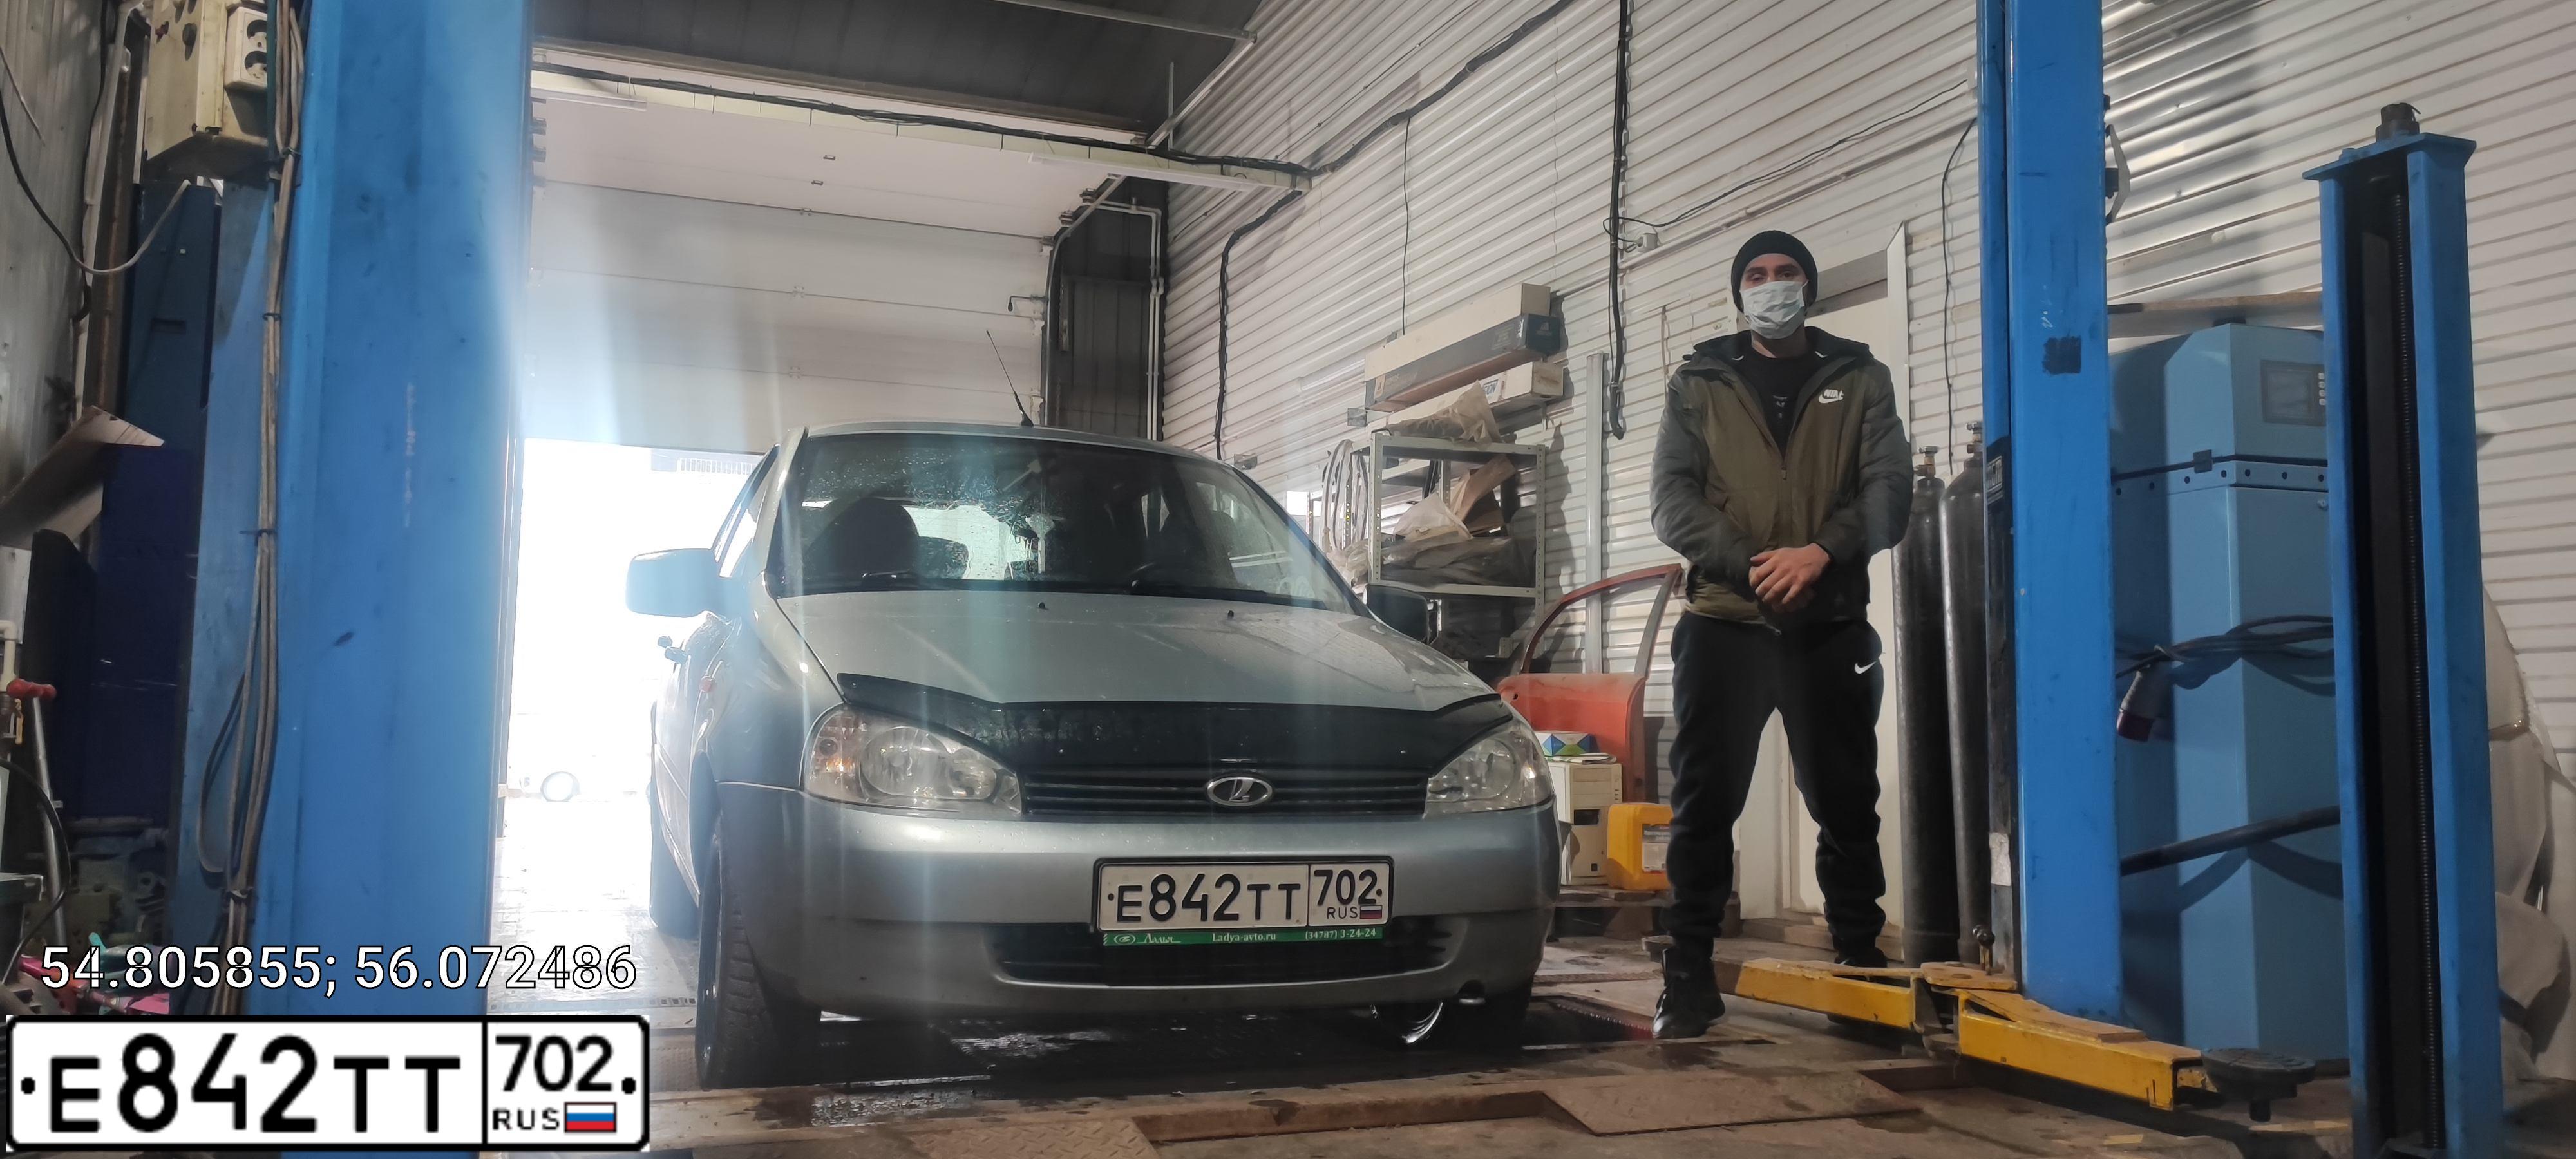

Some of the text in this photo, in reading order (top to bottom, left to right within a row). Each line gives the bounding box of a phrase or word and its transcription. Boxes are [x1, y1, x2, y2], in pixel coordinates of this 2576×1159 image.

[1314, 869, 1378, 905] 702
[1327, 907, 1358, 919] RUS
[1212, 932, 1276, 943] Ladya-avto.ru
[1305, 928, 1376, 940] (34787) 3-24-24
